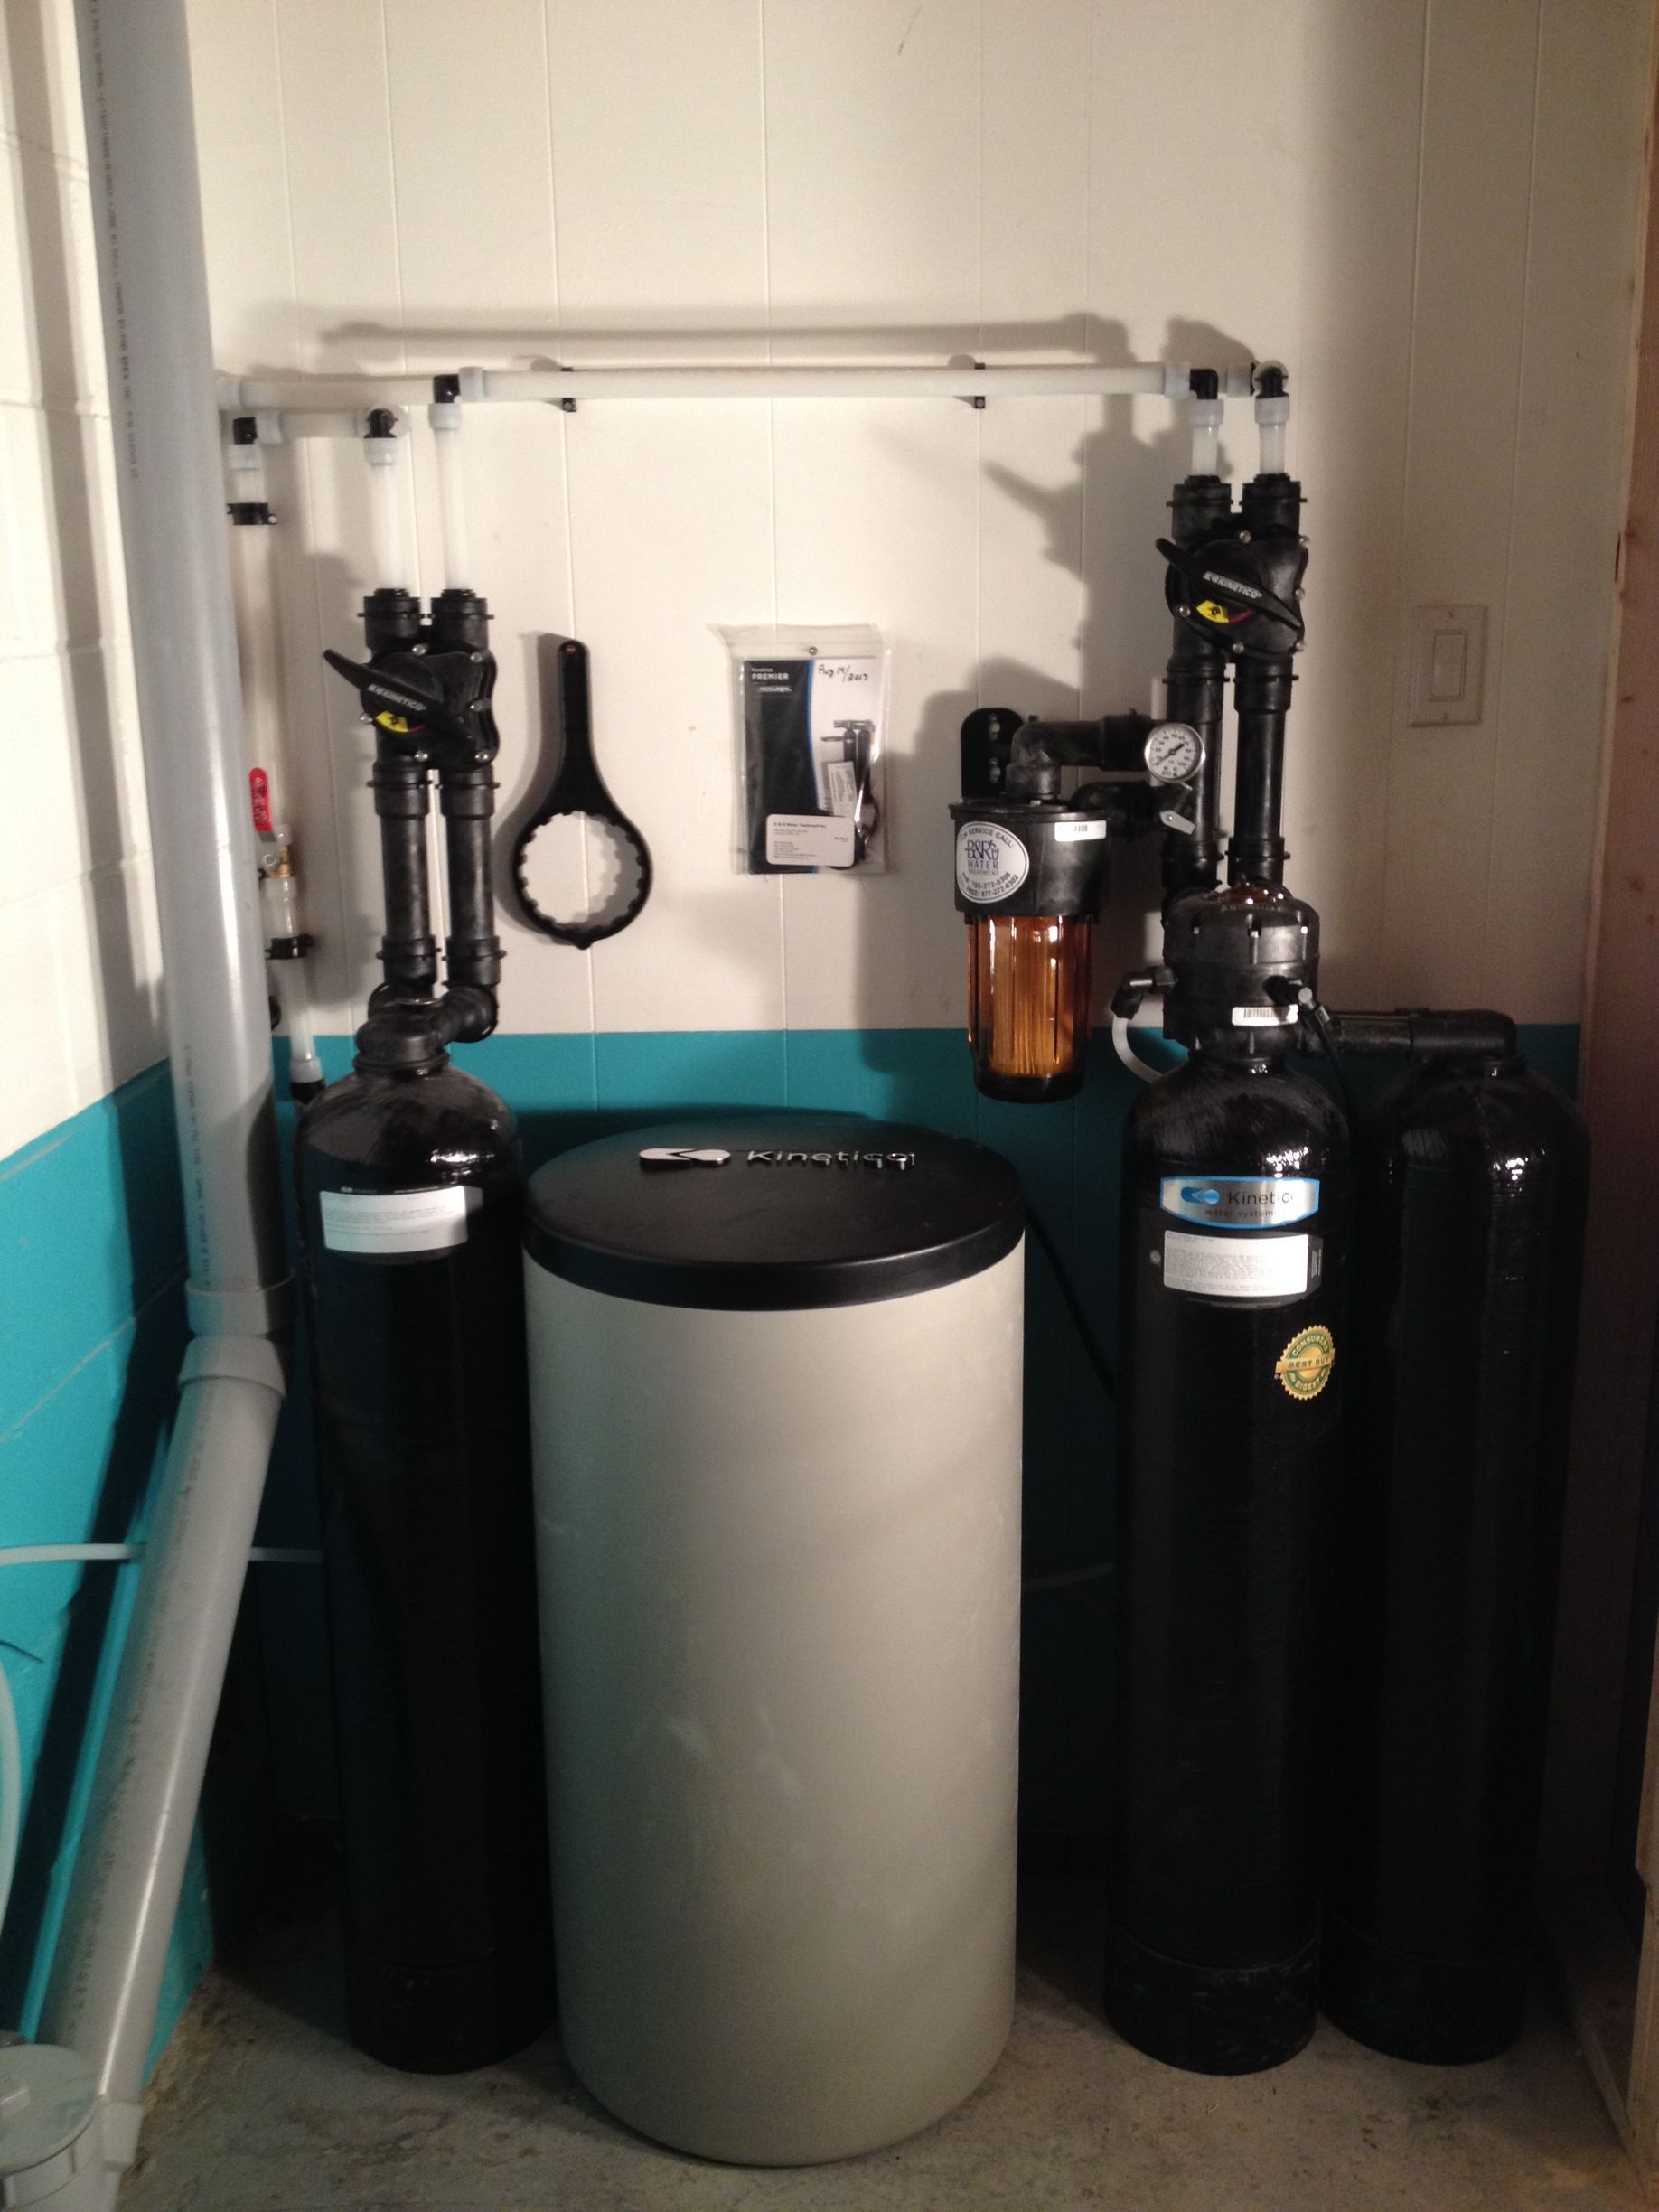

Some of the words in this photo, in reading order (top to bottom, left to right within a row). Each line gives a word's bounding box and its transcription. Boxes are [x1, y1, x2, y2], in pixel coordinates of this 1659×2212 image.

[751, 672, 790, 680] PREMIER
[967, 859, 999, 870] WATER
[746, 1150, 910, 1168] Kinetico
[1228, 1190, 1295, 1206] Kinetic
[1239, 1209, 1273, 1219] system
